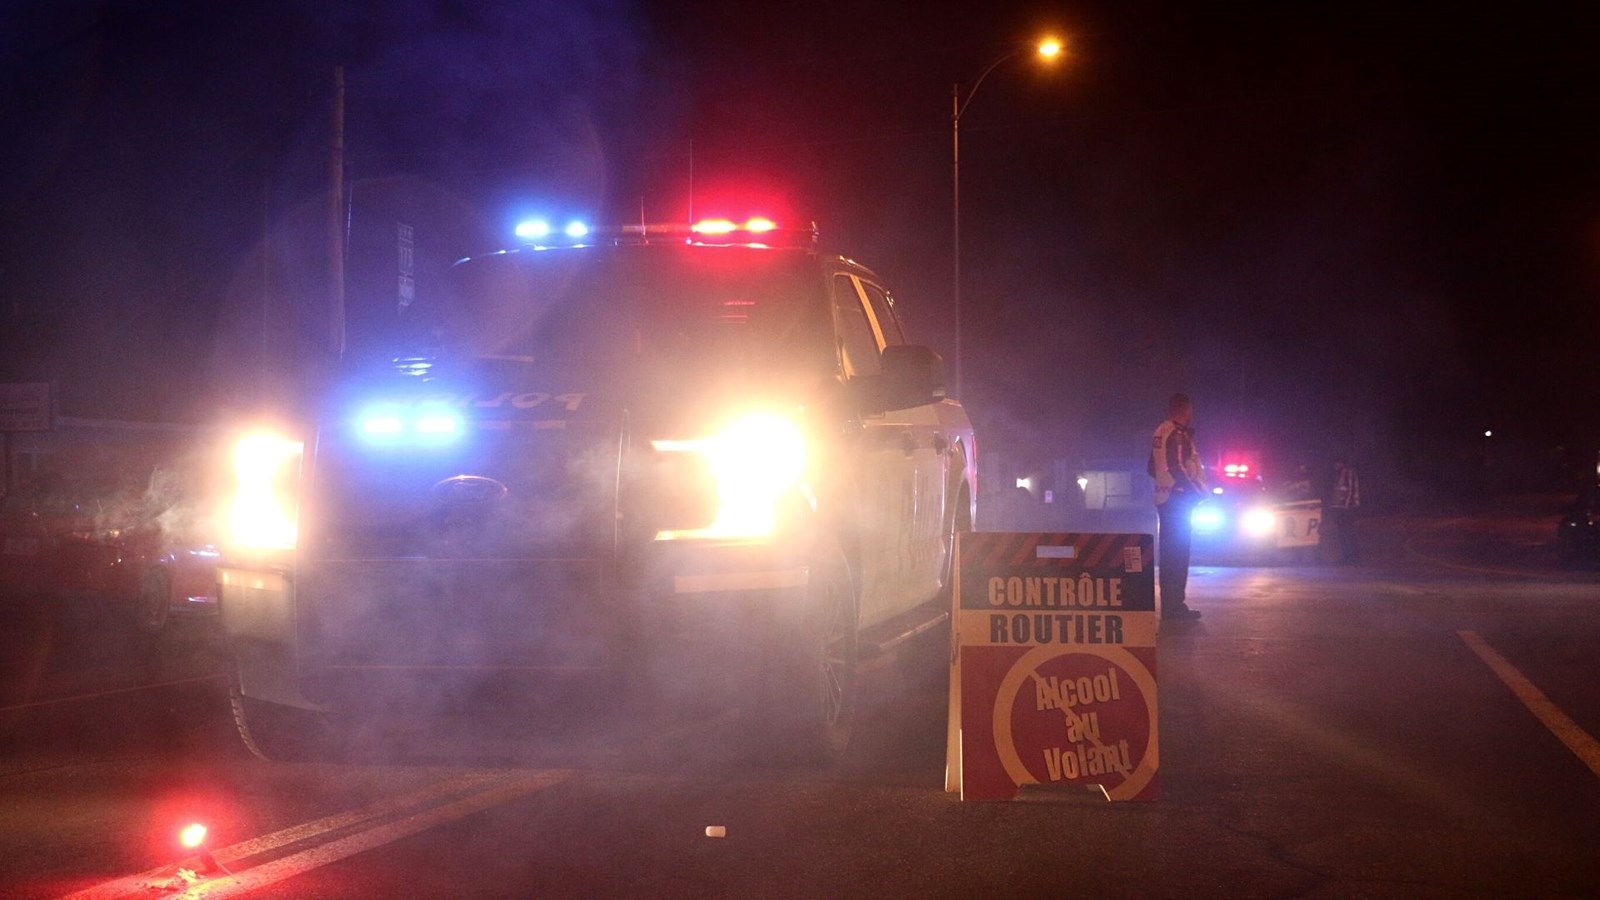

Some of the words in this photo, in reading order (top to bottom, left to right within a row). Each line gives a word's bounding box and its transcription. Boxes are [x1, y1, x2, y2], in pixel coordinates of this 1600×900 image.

[988, 572, 1123, 607] CONTRÔLE
[990, 613, 1124, 644] ROUTIER
[1036, 667, 1120, 711] Alcool
[1065, 712, 1100, 743] au
[1043, 739, 1132, 781] Volant
